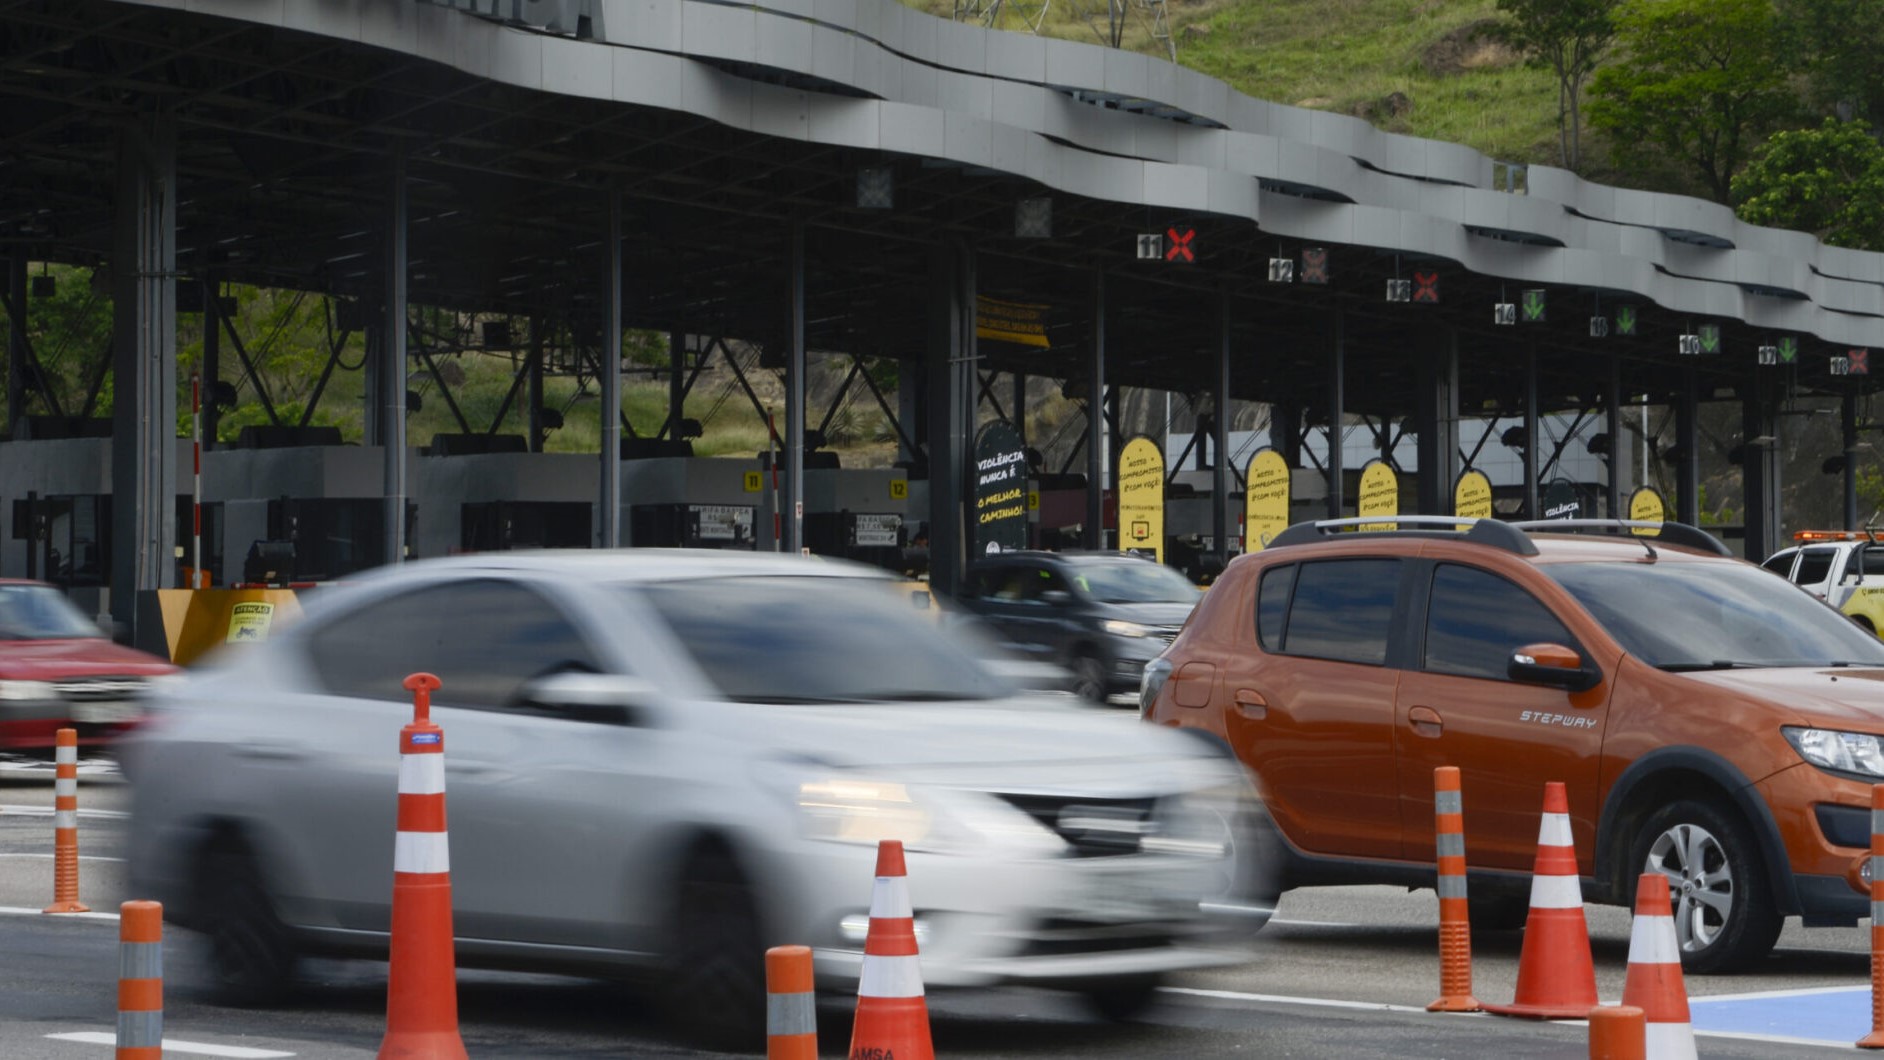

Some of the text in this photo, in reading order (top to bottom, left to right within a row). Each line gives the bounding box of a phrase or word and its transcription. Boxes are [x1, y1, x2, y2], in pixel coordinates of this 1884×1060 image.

[1139, 235, 1161, 258] 11
[1271, 260, 1293, 281] 12
[1497, 305, 1516, 324] 14
[978, 451, 1025, 471] VIOLÊNCIA
[748, 475, 758, 488] 11
[980, 464, 1017, 486] NUNCA É
[893, 482, 904, 496] 12
[978, 488, 1022, 508] O MELHOR
[980, 505, 1024, 524] CAMINHO!
[235, 605, 270, 614] ATENÇÃO
[1520, 710, 1598, 729] STEPWAY
